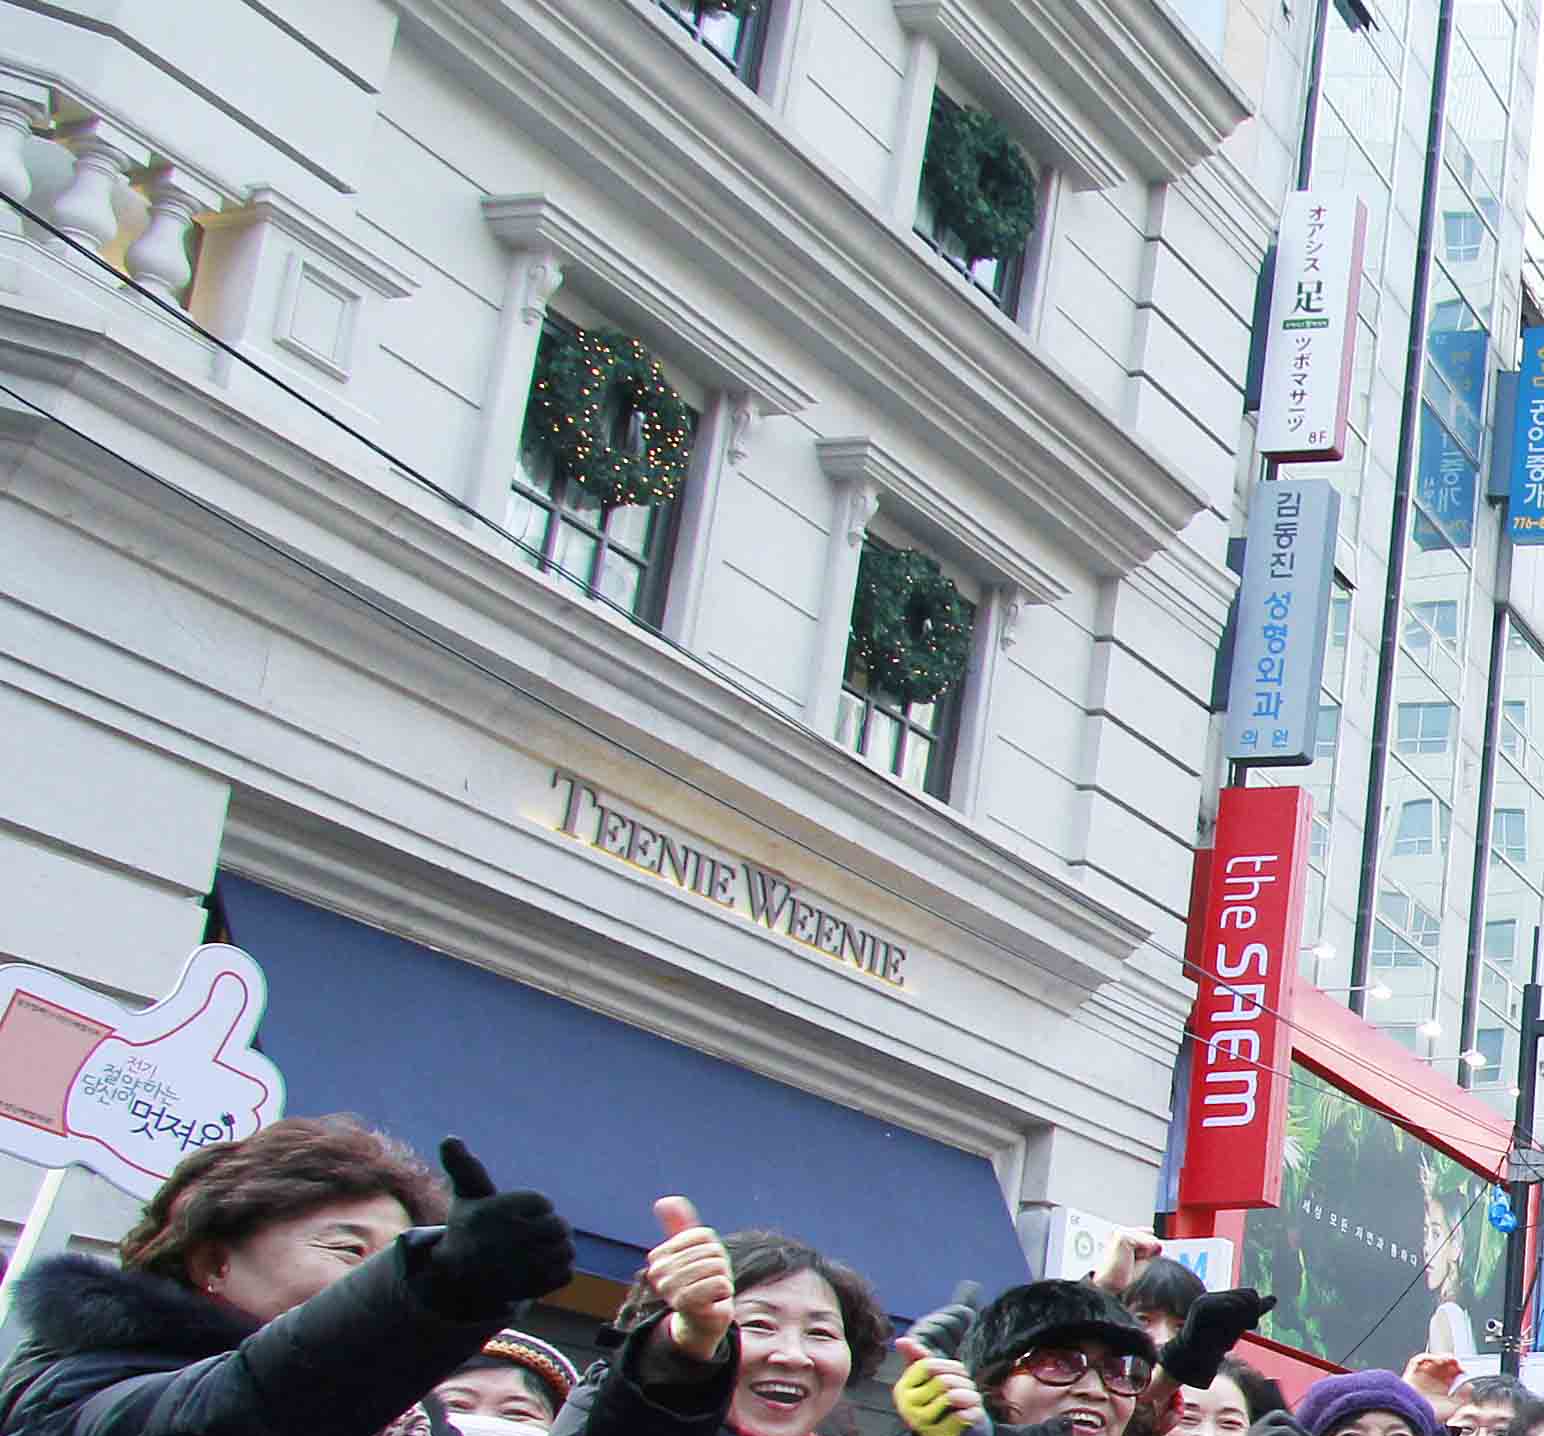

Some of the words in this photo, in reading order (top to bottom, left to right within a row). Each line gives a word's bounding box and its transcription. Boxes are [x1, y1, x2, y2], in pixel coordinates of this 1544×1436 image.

[1291, 281, 1323, 313] 足
[1271, 492, 1300, 579] 김동진
[1252, 591, 1292, 720] 성형외과
[1240, 729, 1289, 749] 의원
[552, 767, 736, 908] TEENIE
[740, 862, 907, 987] WEENIE
[1219, 855, 1278, 929] the
[104, 1063, 180, 1107] 절약하는
[127, 1056, 157, 1077] 전기
[82, 1073, 136, 1110] 당신이
[131, 1100, 230, 1151] 멋져요
